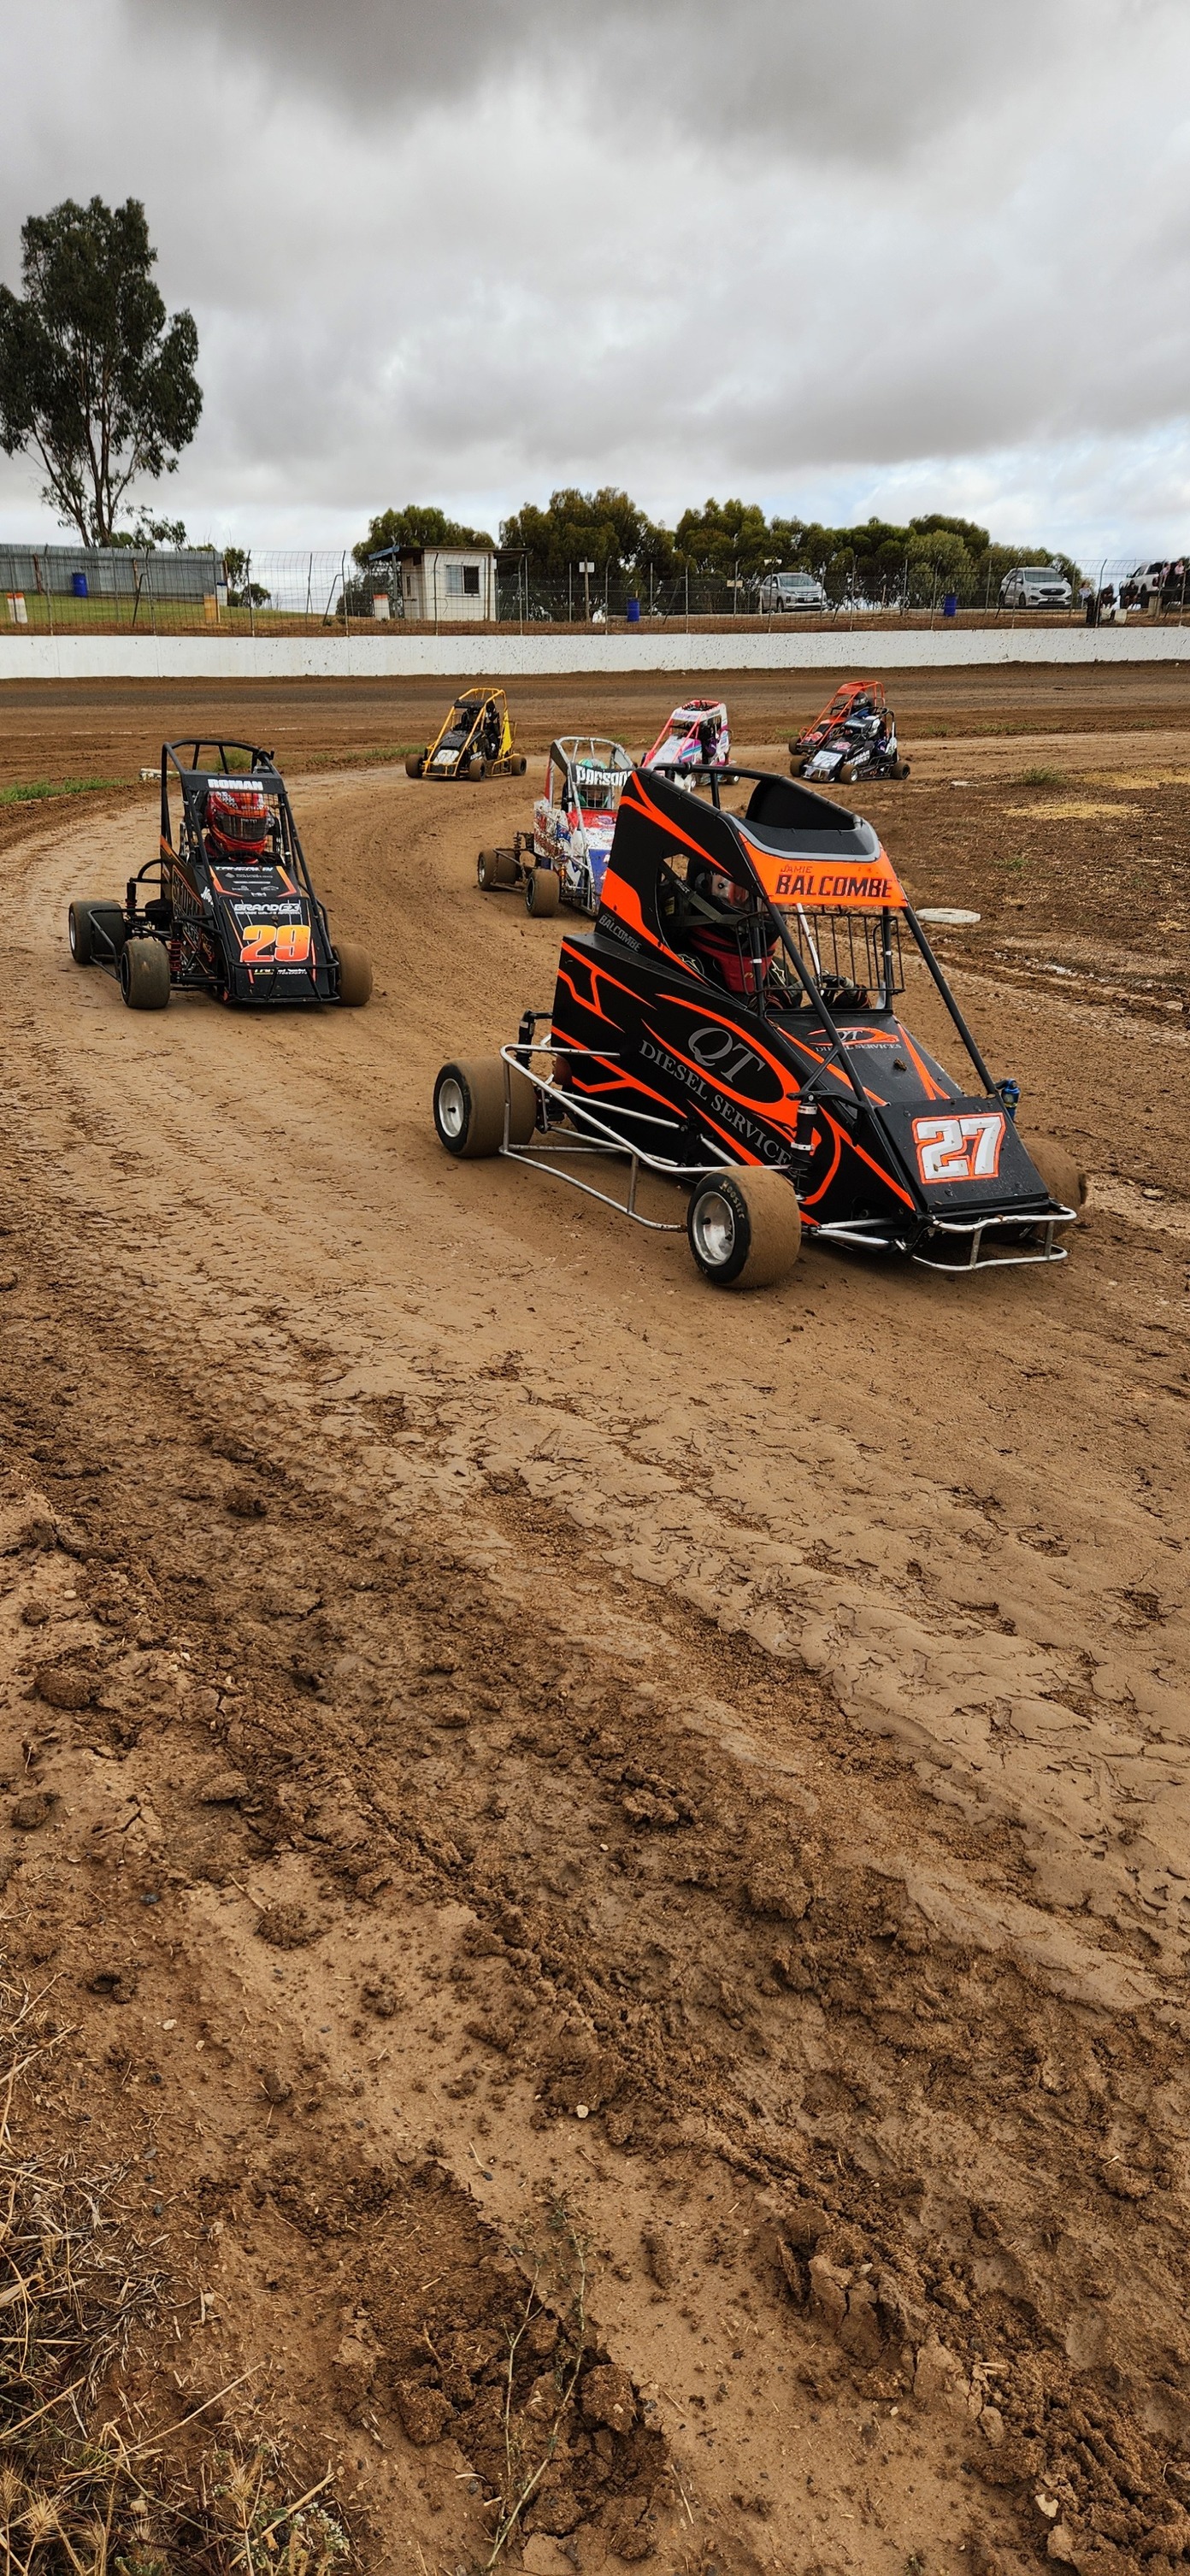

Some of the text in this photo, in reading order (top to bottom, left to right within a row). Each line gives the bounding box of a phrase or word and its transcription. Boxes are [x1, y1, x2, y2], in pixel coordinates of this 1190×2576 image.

[207, 779, 263, 791] ROMAN
[575, 765, 633, 787] PARSON
[775, 874, 893, 898] BALCOMBE
[780, 864, 813, 874] JAMIE
[240, 924, 311, 963] 29
[598, 914, 643, 952] BALCOMBE
[687, 1027, 766, 1083] QT
[639, 1040, 792, 1165] DIESEL SERVICE
[912, 1113, 1005, 1183] 27
